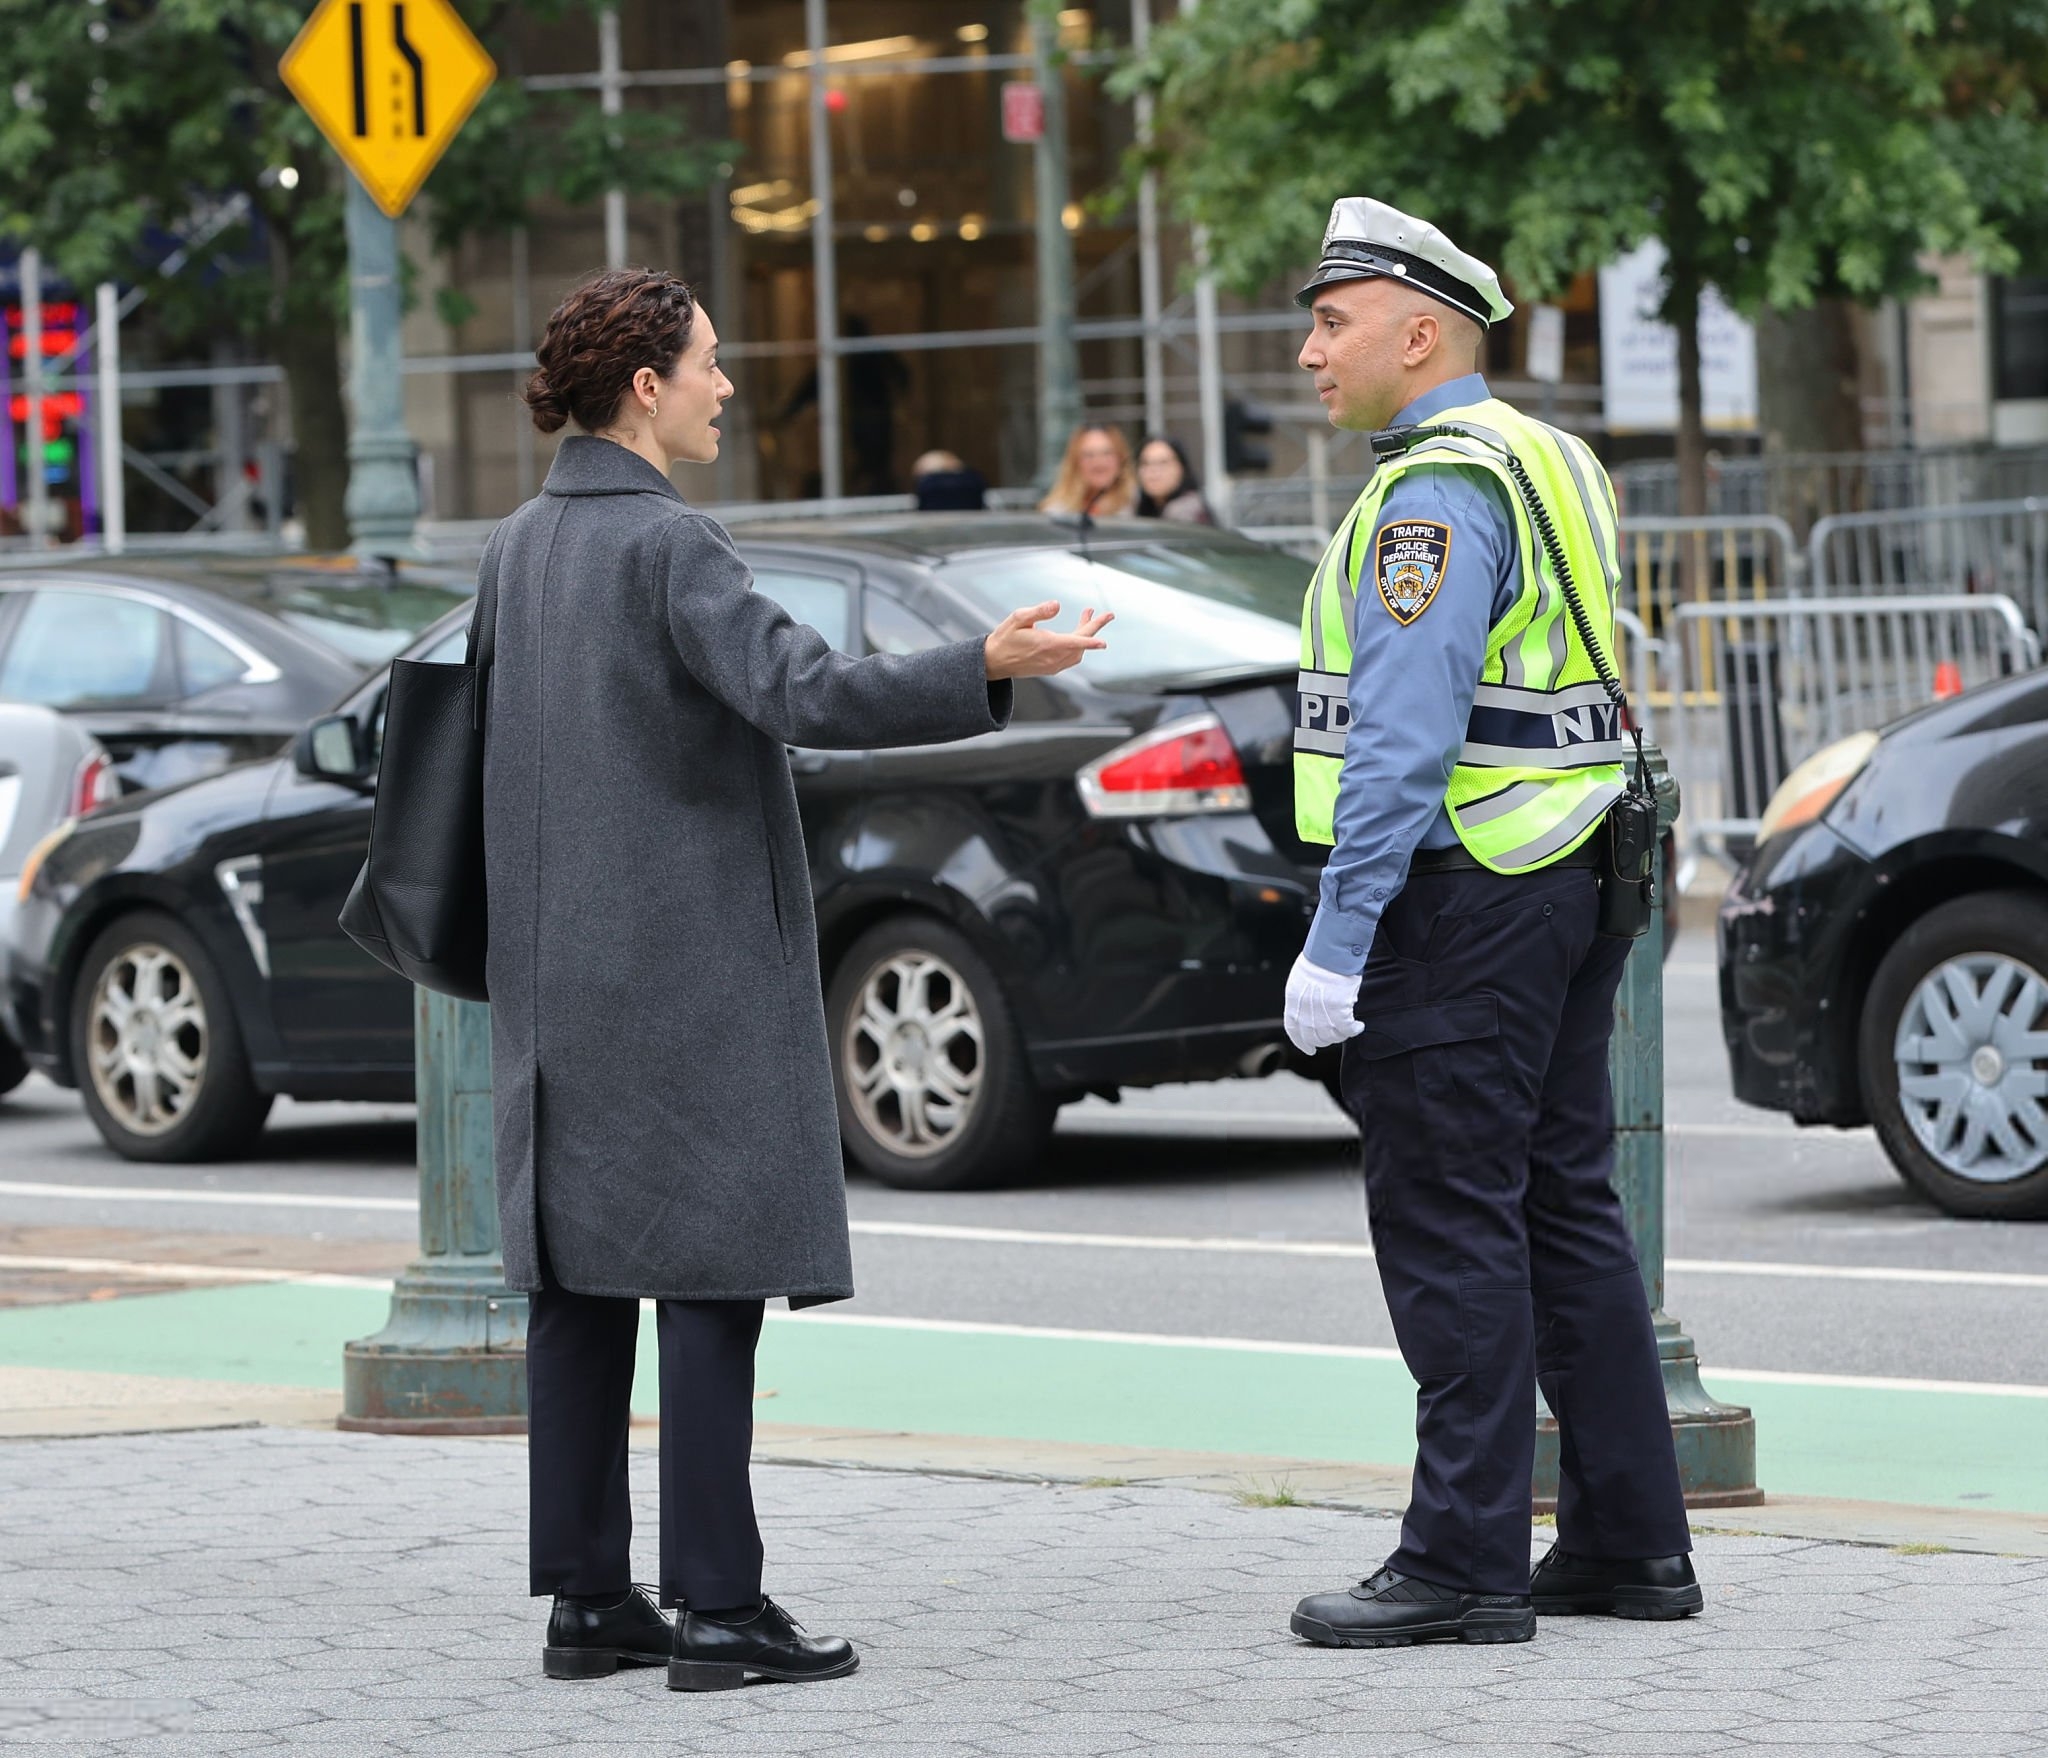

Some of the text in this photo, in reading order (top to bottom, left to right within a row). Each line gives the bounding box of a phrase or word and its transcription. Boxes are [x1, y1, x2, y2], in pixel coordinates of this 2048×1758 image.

[1392, 526, 1435, 538] TRAFFIC
[1395, 541, 1429, 552] POLICE
[1383, 551, 1439, 565] DEPARTMENT
[1381, 577, 1399, 609] CITY OF
[1410, 571, 1440, 613] NEW YORK
[1301, 693, 1353, 732] PD
[1552, 704, 1621, 747] NY
